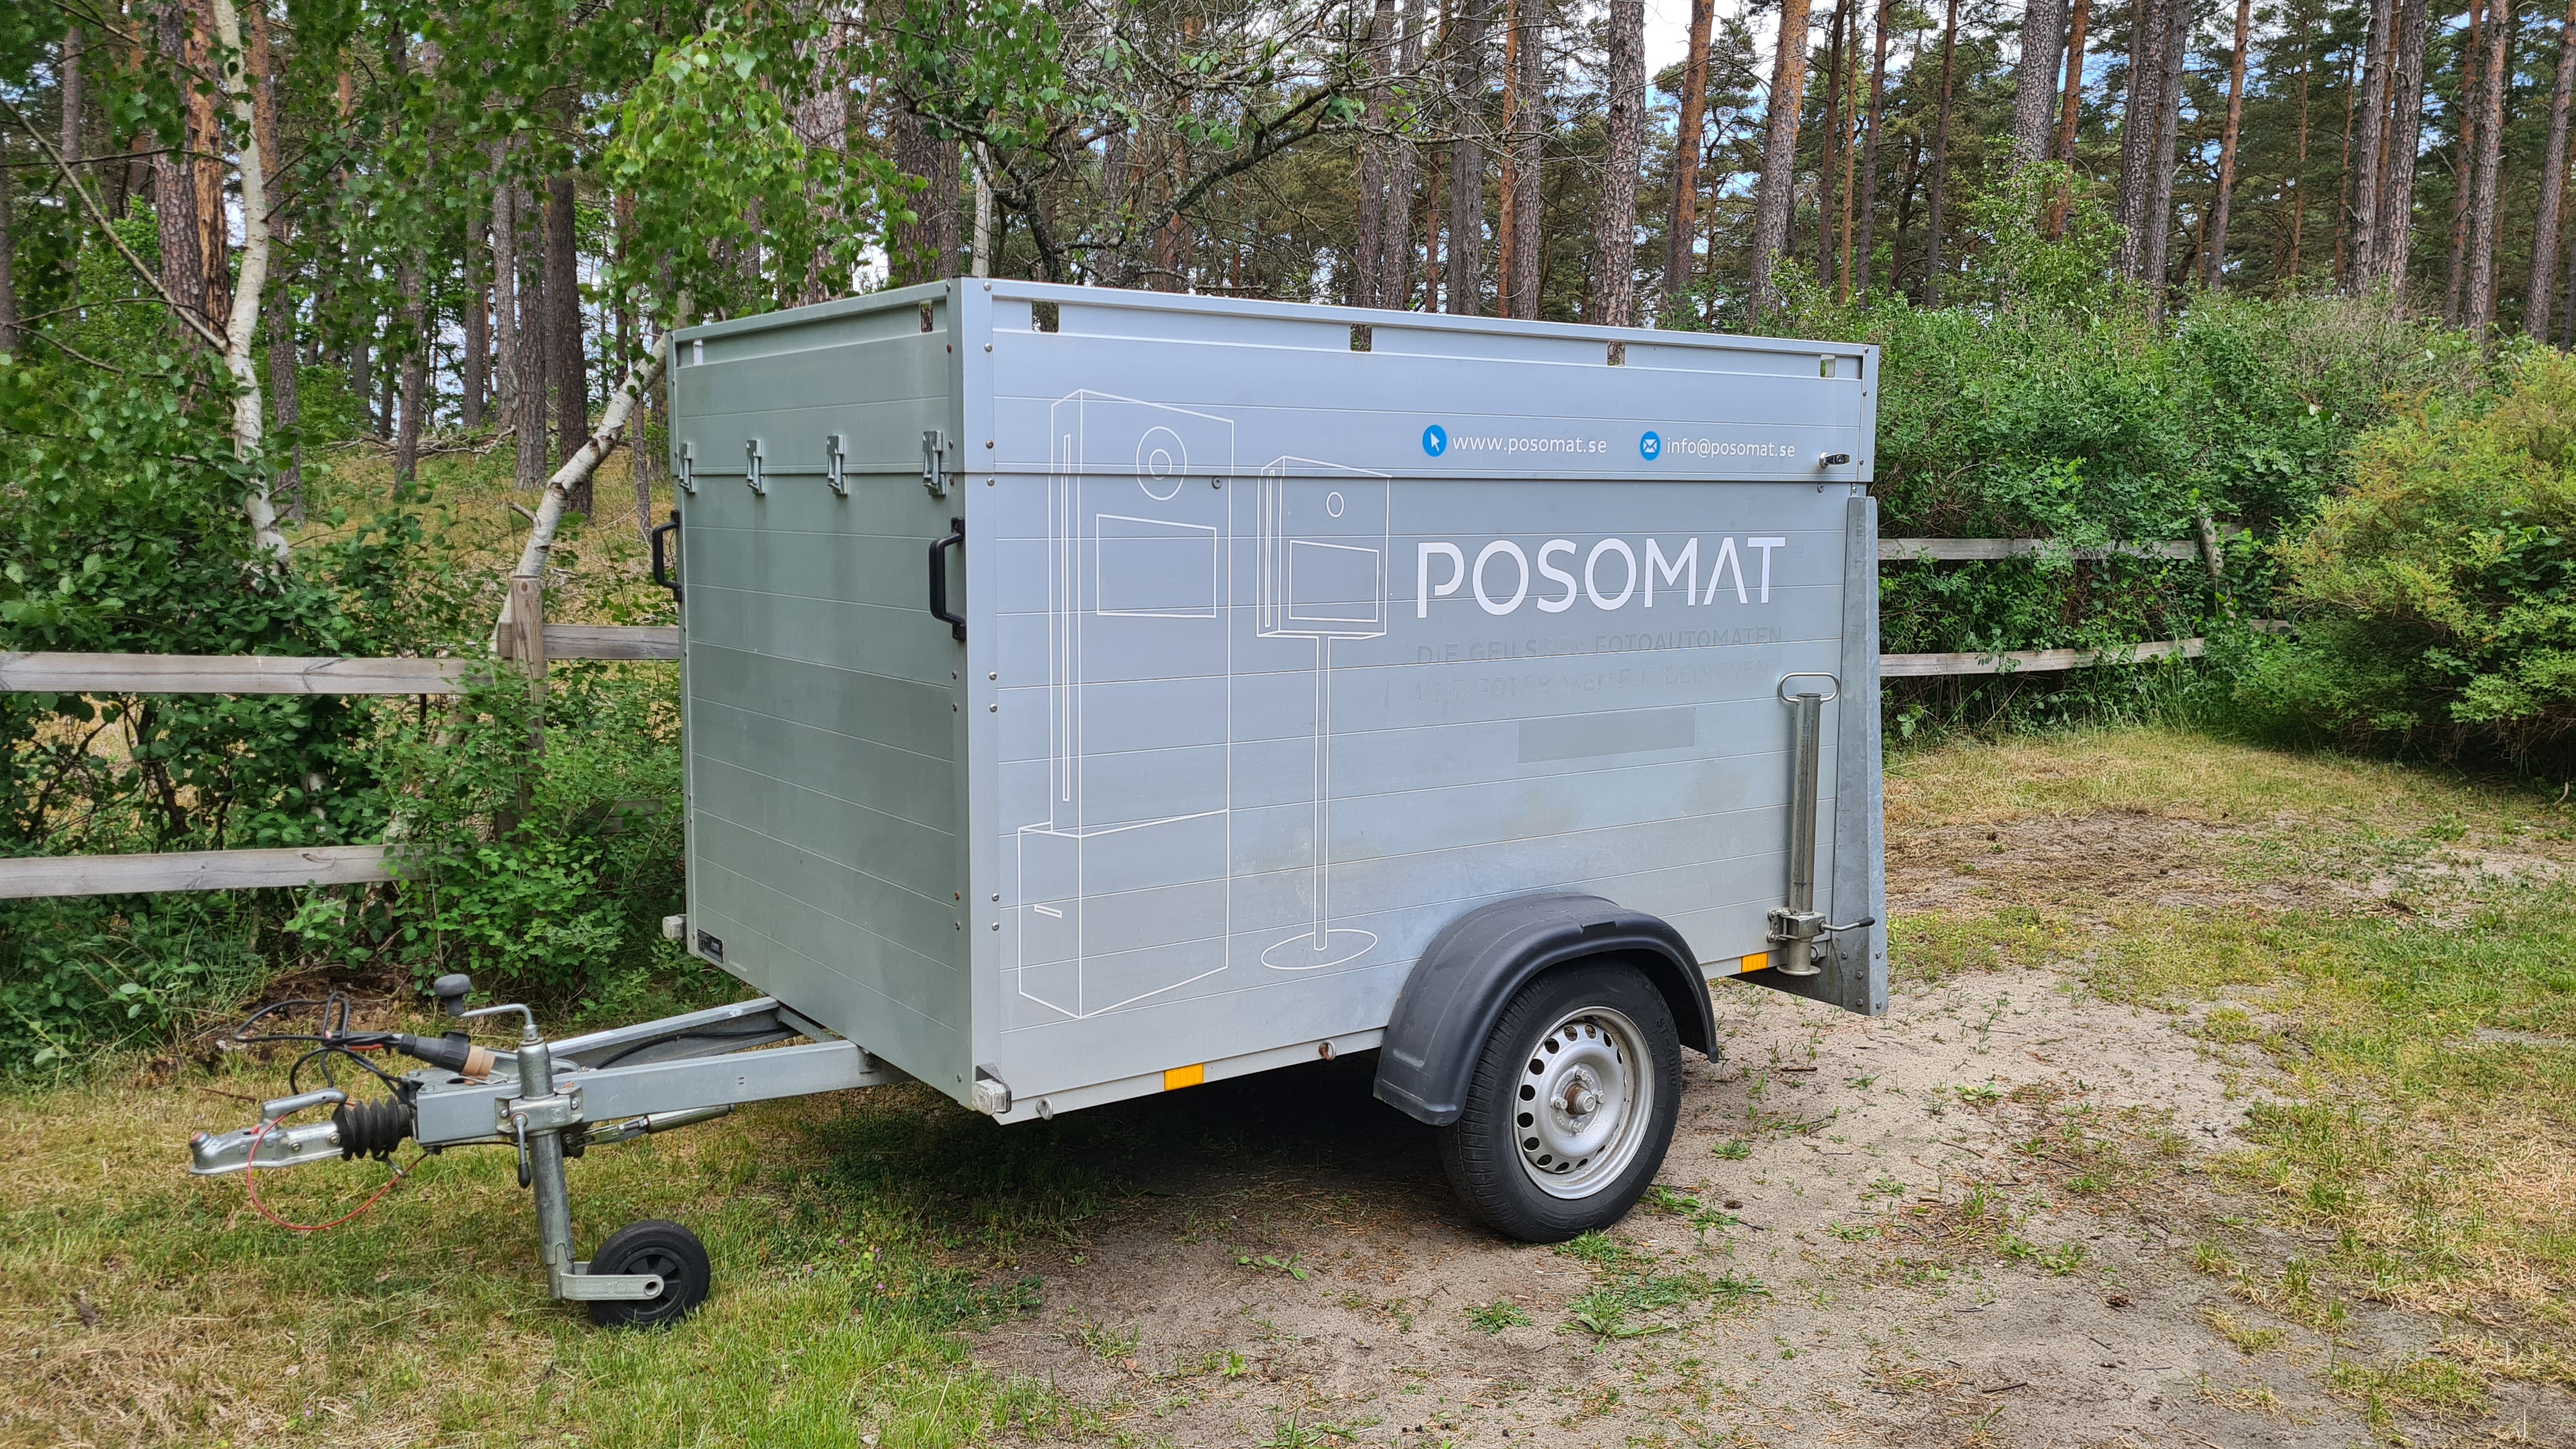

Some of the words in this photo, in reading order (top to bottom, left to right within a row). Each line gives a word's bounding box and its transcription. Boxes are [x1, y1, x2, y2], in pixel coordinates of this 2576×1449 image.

[1452, 436, 1607, 455] www.posomat.se
[1666, 436, 1796, 459] info@posomat.se
[1416, 537, 1786, 618] POSOMAT
[1417, 644, 1459, 666] DIE
[1595, 626, 1782, 652] FOTOAUTOMATEN
